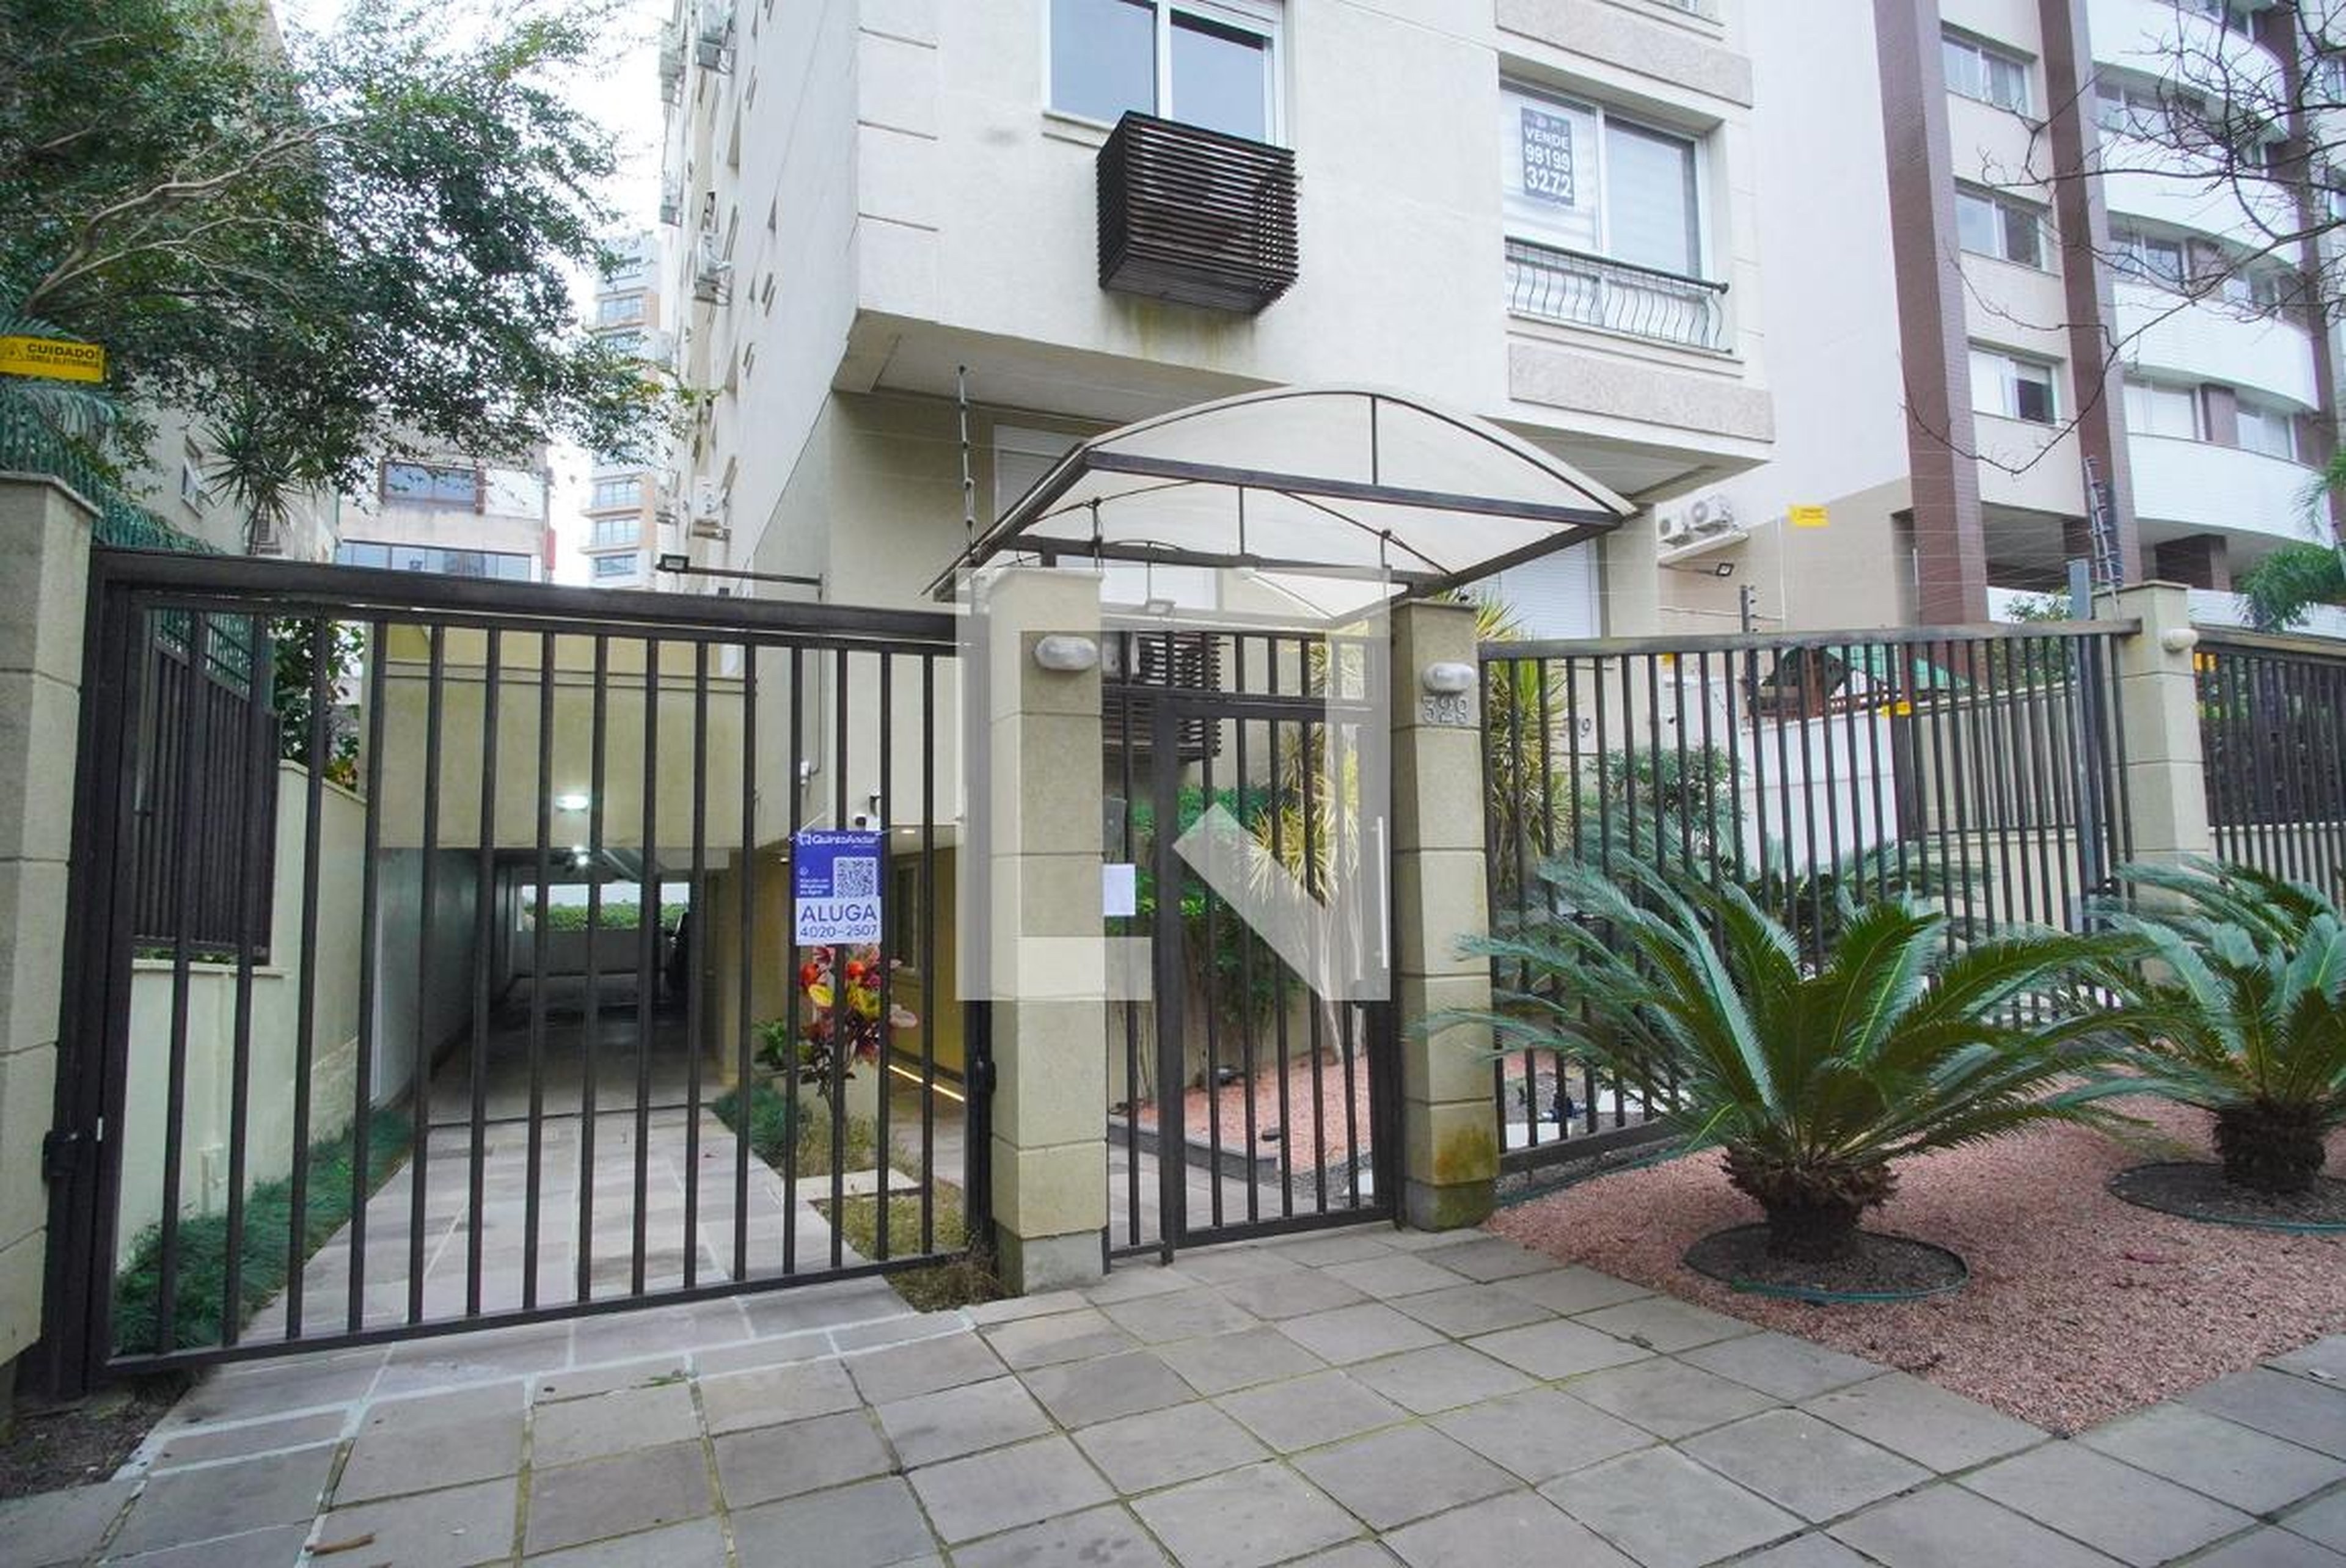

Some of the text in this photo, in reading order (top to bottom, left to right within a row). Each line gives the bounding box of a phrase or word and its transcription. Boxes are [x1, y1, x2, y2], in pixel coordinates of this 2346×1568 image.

[1525, 126, 1569, 150] VENDE
[1527, 166, 1573, 197] 3272
[800, 904, 877, 922] ALUGA
[800, 925, 877, 938] 4020-2507
